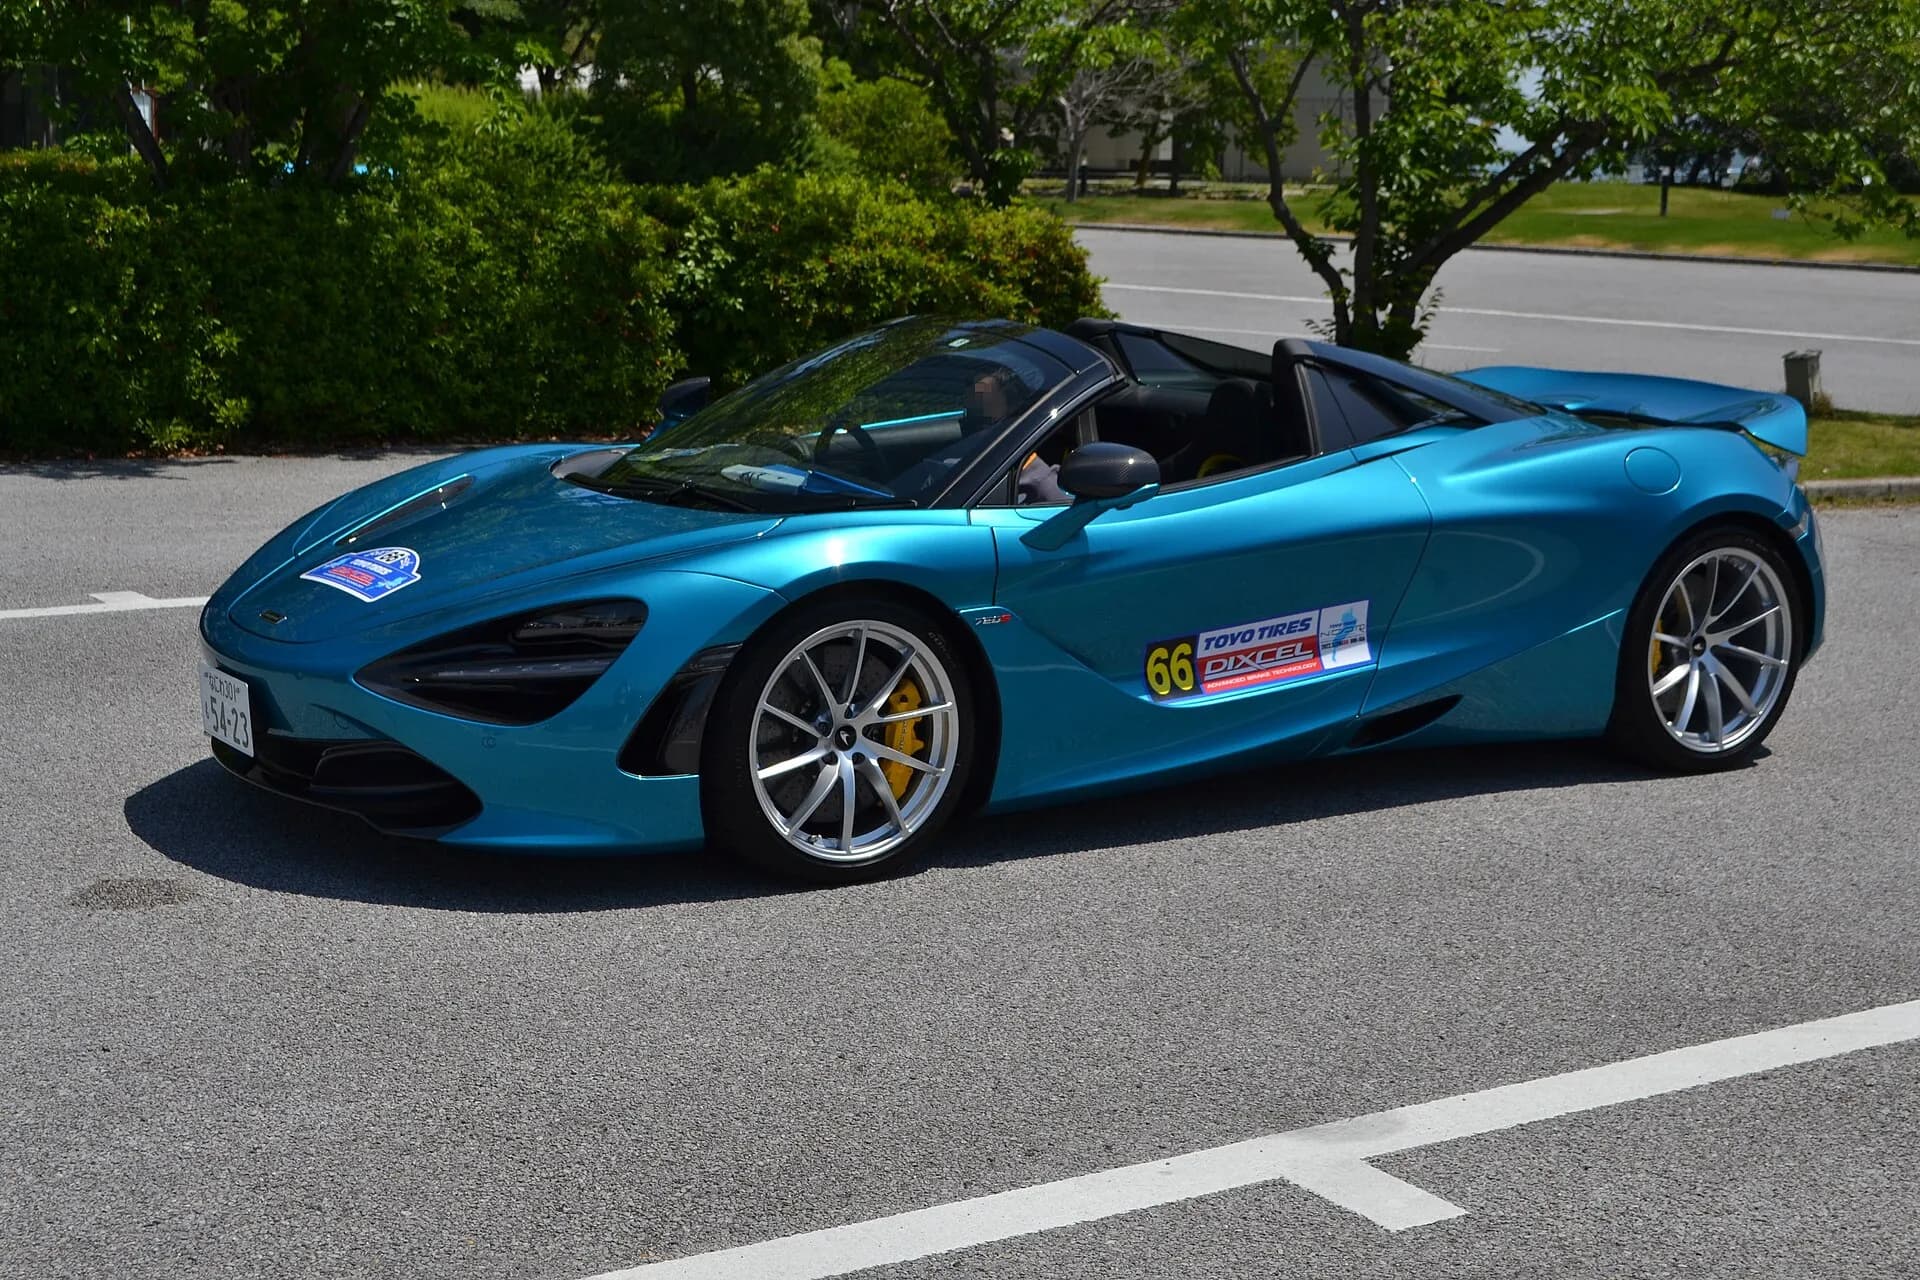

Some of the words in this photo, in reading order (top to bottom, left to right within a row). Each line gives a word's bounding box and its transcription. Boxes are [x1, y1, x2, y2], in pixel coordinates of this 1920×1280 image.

[1204, 629, 1255, 650] TOYO
[1257, 617, 1313, 640] TIRES
[1146, 643, 1194, 695] 66
[1204, 642, 1314, 676] DIXCEL
[1272, 662, 1317, 676] TECHNOLOGY
[210, 695, 249, 748] 54-23
